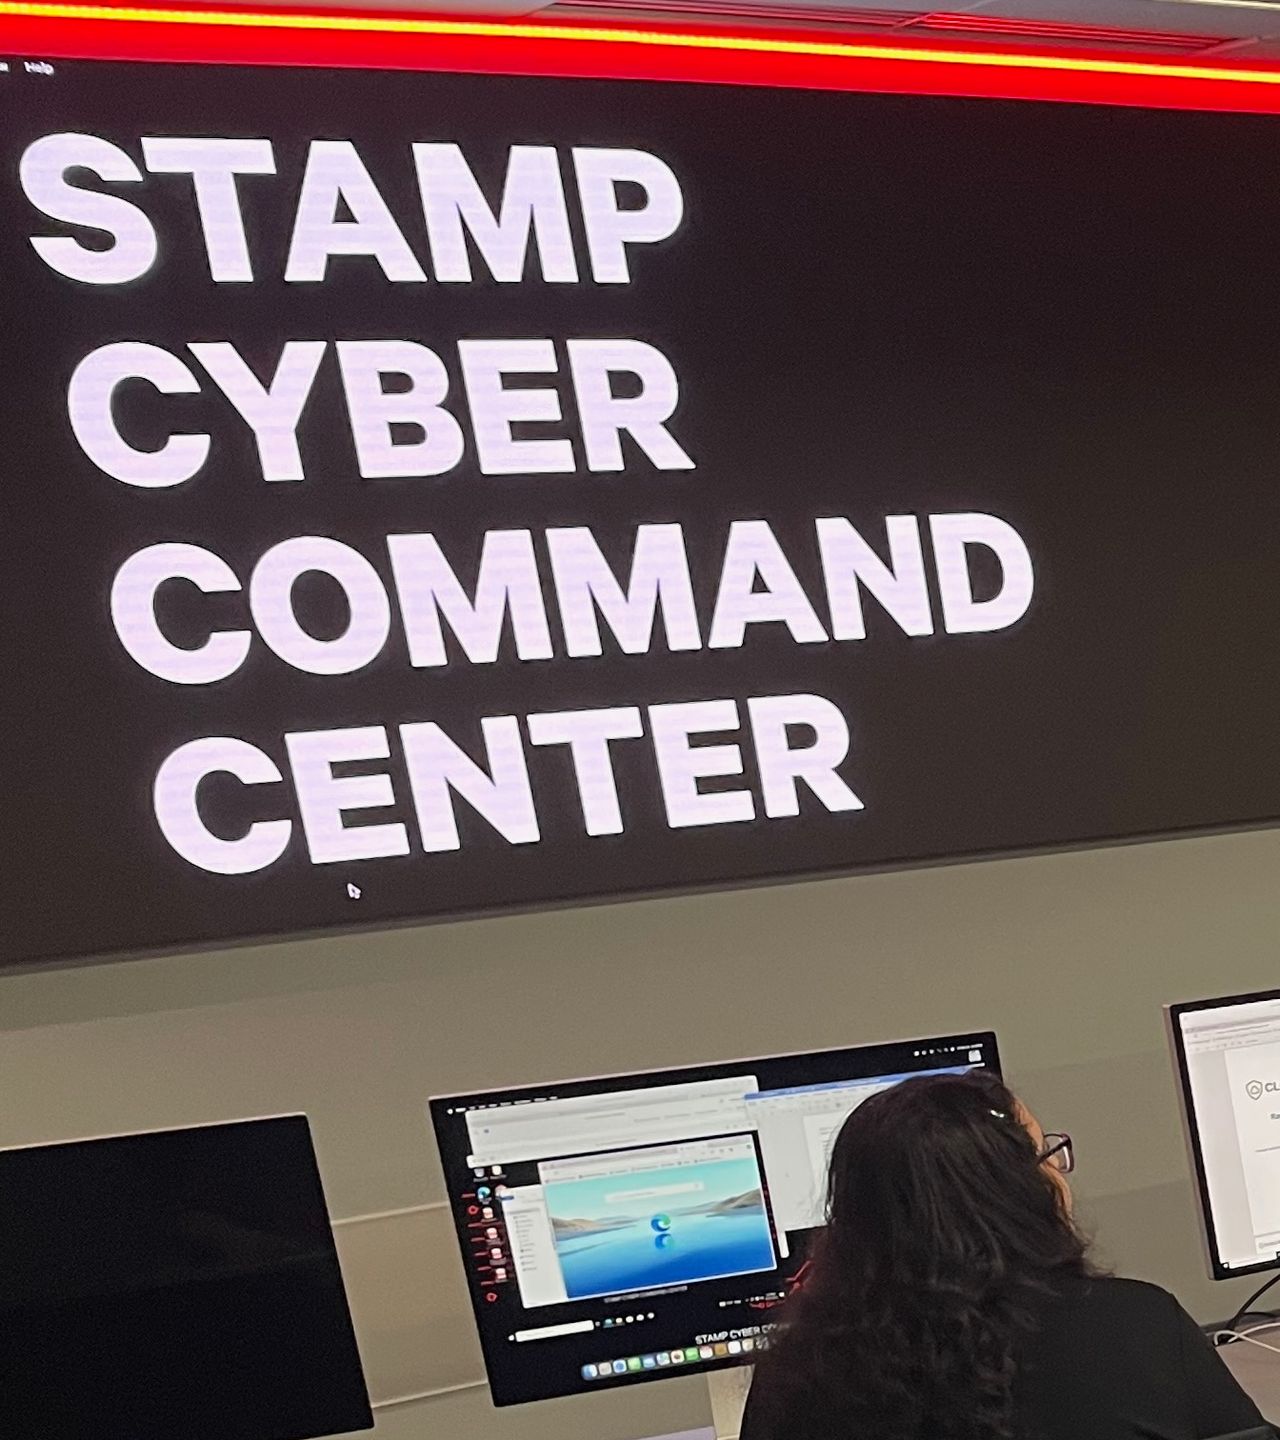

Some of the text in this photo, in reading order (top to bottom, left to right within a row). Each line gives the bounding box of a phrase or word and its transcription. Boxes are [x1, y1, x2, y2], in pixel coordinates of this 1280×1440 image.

[19, 131, 684, 285] STAMP
[67, 338, 695, 488] CYBER
[110, 512, 1035, 685] COMMAND
[154, 693, 865, 876] CENTER
[694, 1329, 729, 1345] STAMP
[728, 1324, 760, 1339] CYBER
